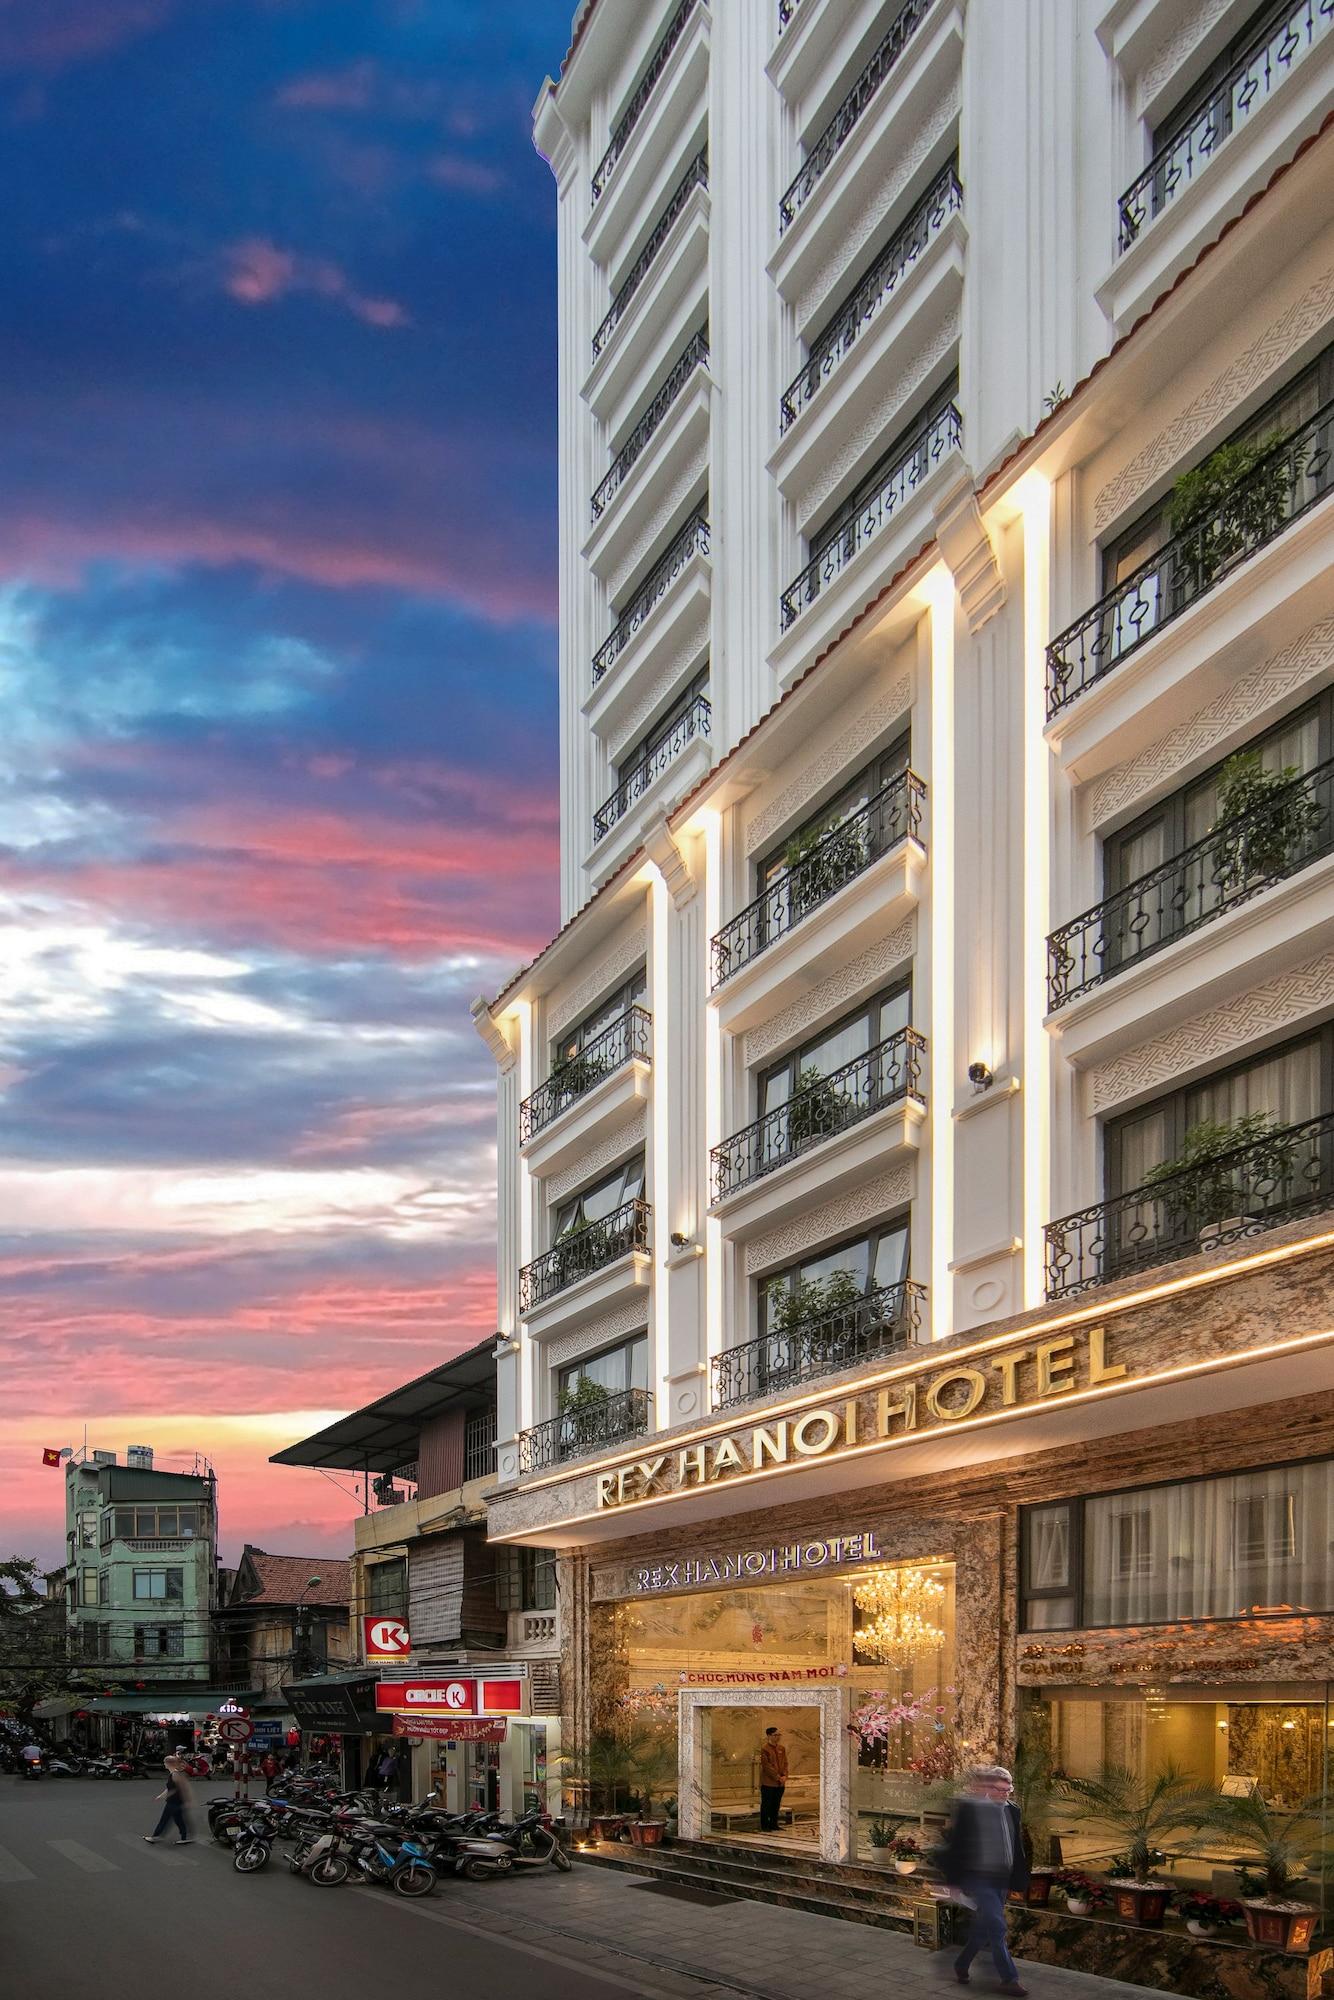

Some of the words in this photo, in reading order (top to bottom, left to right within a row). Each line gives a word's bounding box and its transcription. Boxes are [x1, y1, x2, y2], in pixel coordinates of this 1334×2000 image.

[596, 1456, 672, 1508] REX
[679, 1400, 858, 1483] HANOI
[878, 1327, 1127, 1437] HOTEL
[636, 1563, 679, 1590] REX
[684, 1548, 776, 1584] HANOI
[781, 1532, 881, 1571] HOTEL
